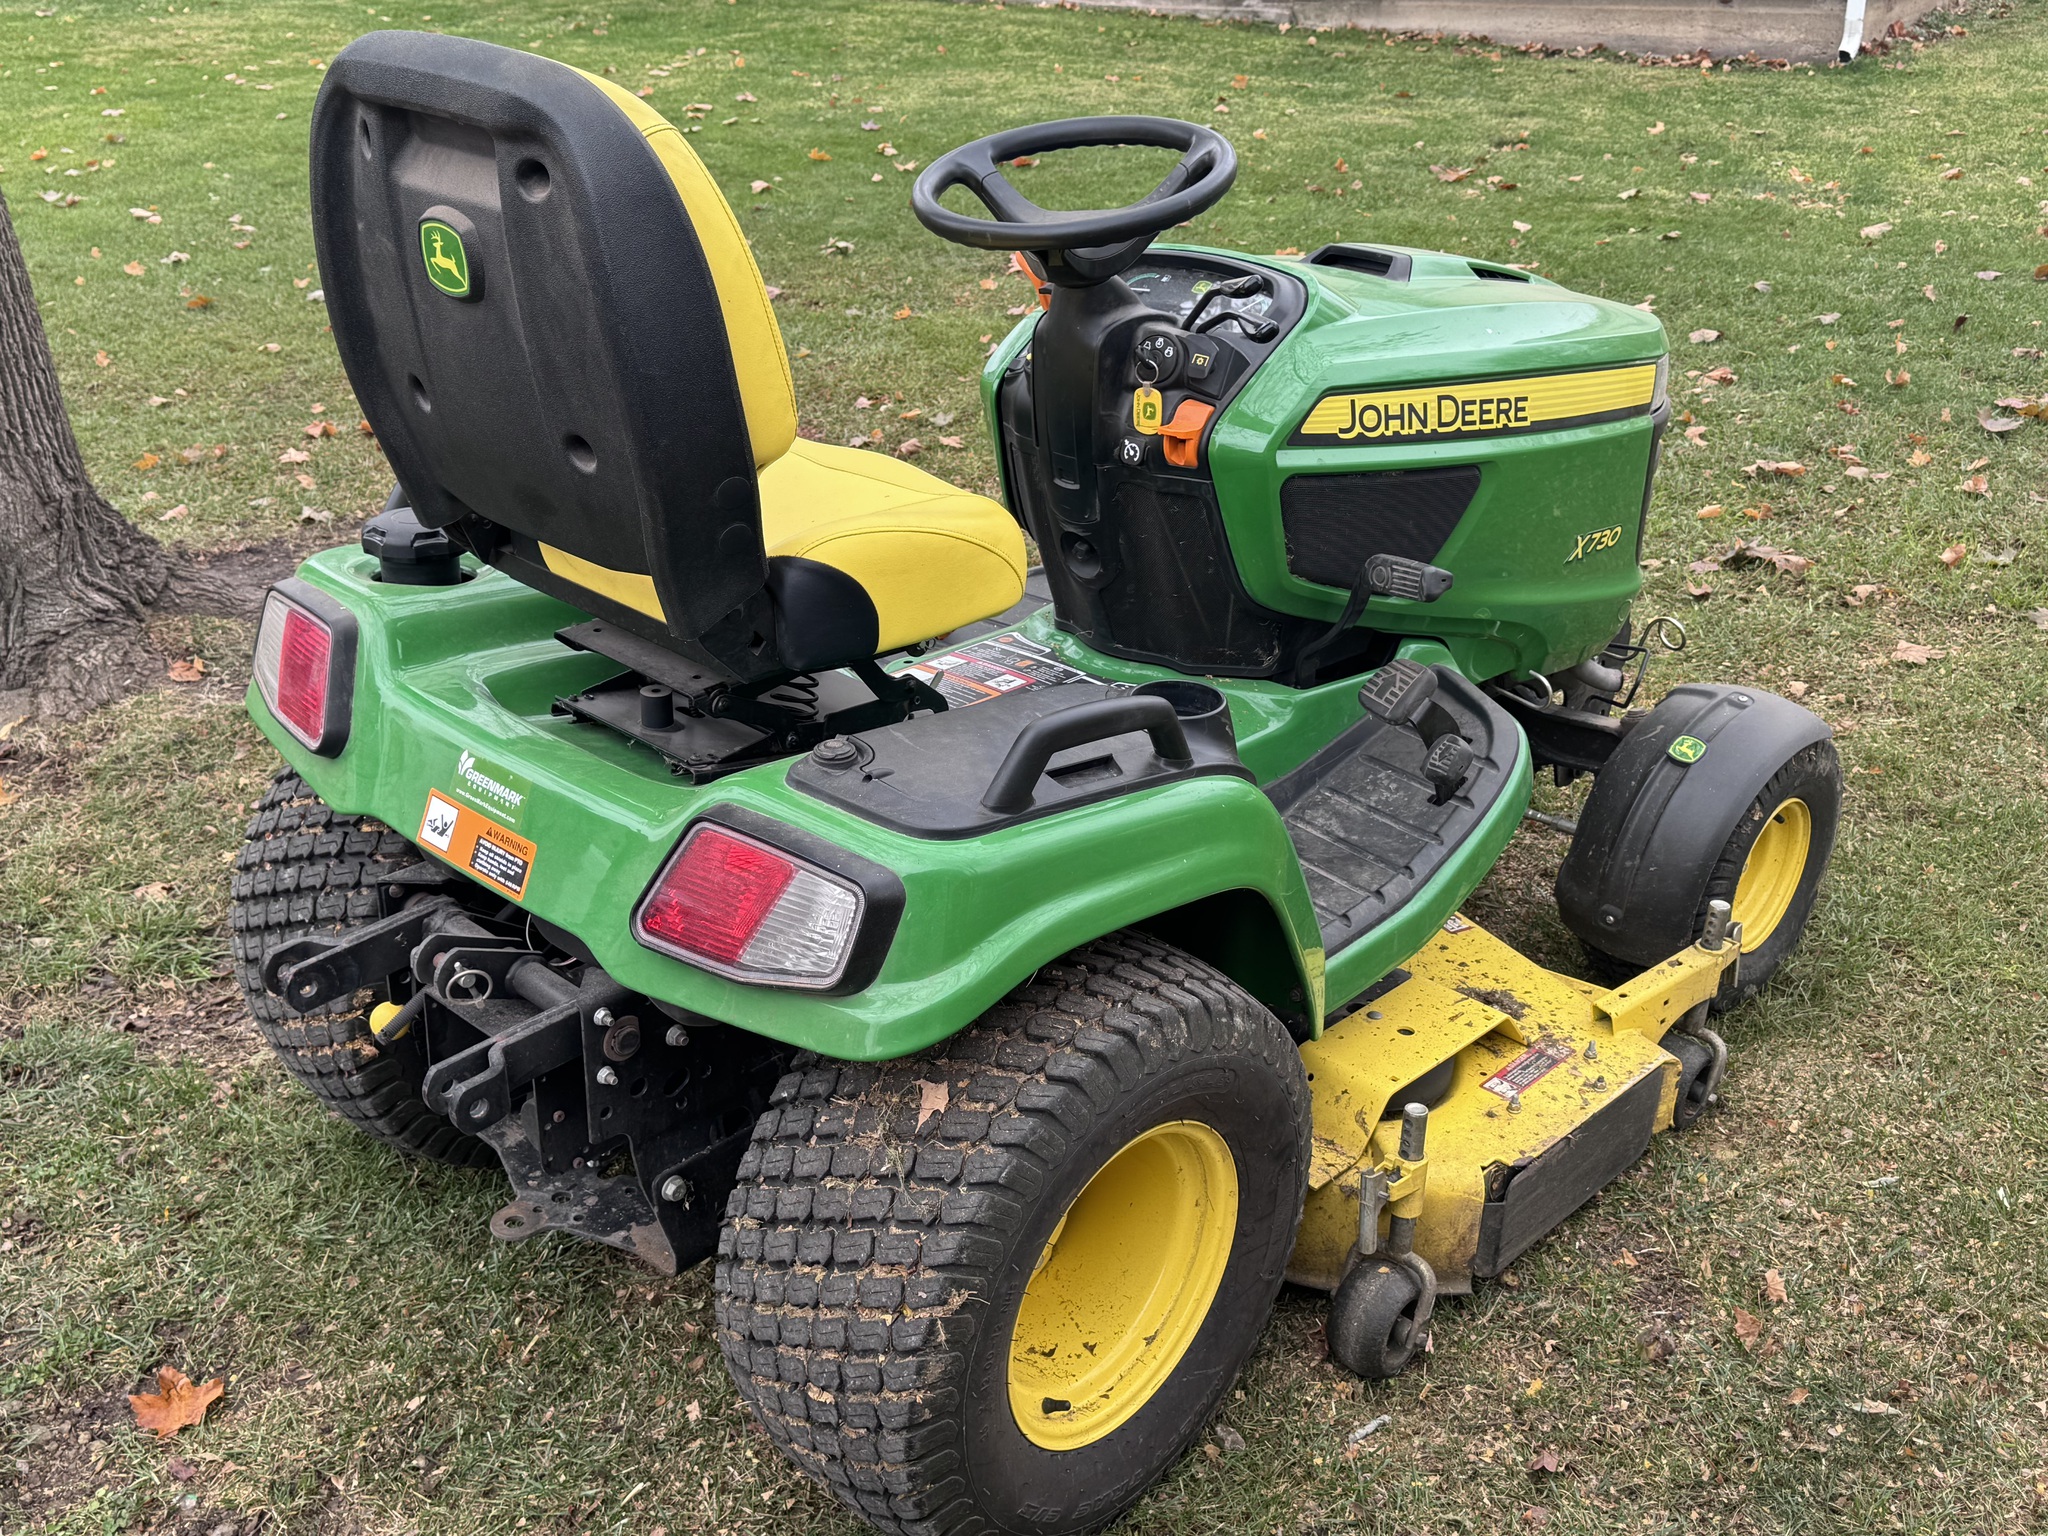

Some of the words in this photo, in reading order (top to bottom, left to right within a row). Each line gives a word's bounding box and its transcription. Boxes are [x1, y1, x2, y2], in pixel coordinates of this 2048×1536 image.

[1338, 398, 1429, 437] JOHN
[1437, 394, 1530, 431] DEERE
[1565, 524, 1623, 563] X730
[465, 768, 523, 806] GREENMARK
[493, 829, 529, 856] WARNING
[514, 857, 524, 866] PTO
